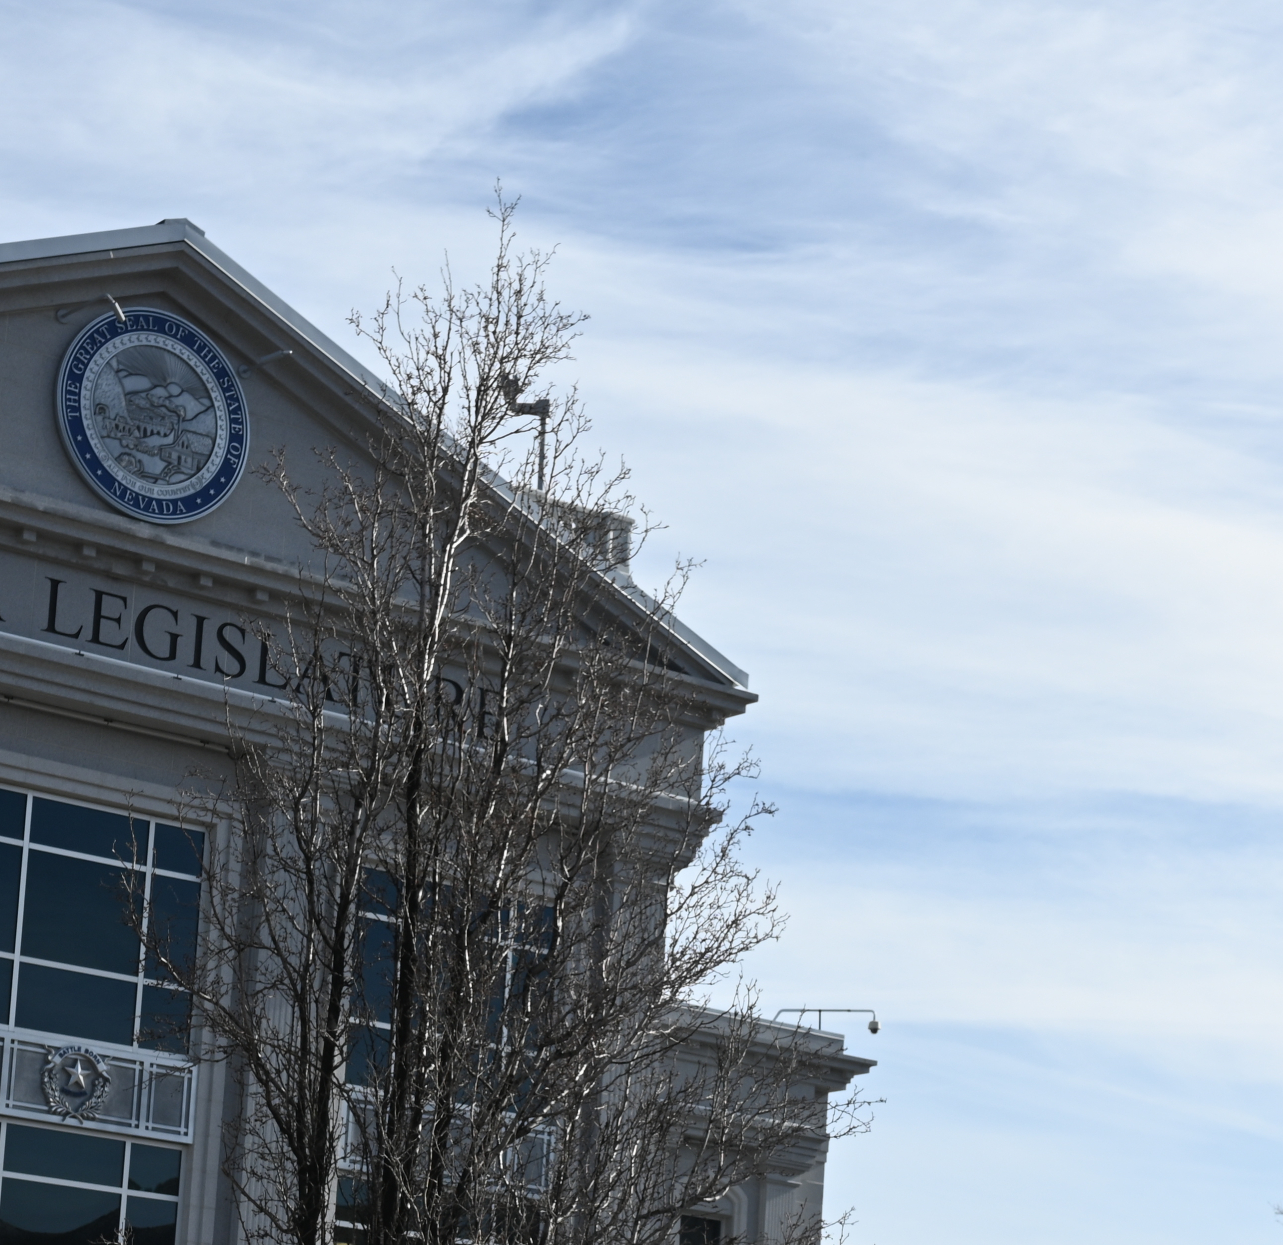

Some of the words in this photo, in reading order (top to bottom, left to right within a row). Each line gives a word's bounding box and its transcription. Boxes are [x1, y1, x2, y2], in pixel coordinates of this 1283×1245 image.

[115, 316, 158, 333] SEAL
[165, 322, 189, 339] OF
[72, 325, 112, 374] GREAT
[194, 336, 222, 373] THE
[67, 381, 80, 419] THE
[219, 377, 243, 435] STATE
[227, 443, 242, 468] OF
[110, 480, 187, 514] NEVADA
[59, 1046, 81, 1059] BATTLE
[84, 1048, 101, 1064] BORN
